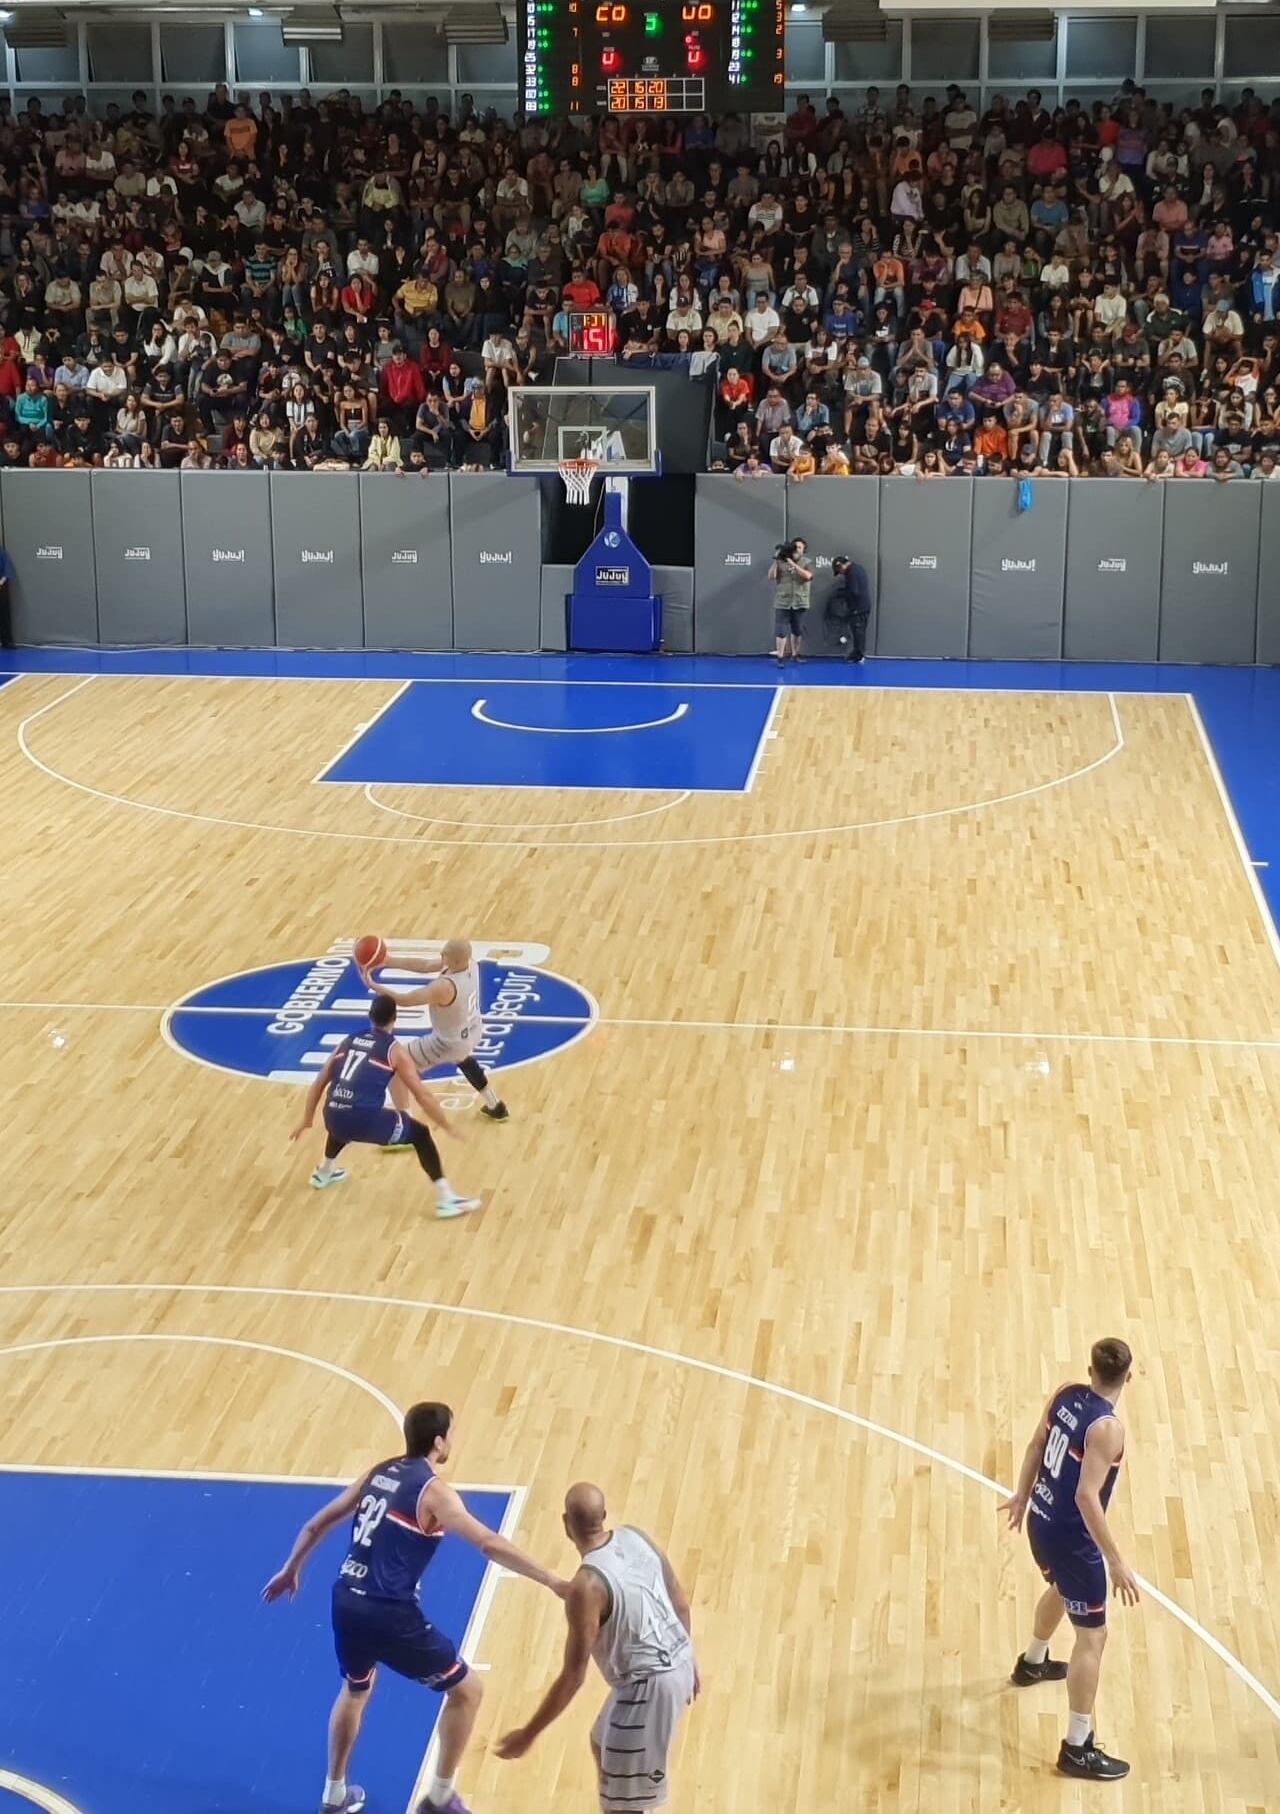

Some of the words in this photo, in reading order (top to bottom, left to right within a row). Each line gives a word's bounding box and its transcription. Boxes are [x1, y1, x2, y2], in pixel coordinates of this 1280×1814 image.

[611, 81, 626, 94] 22
[635, 81, 645, 94] 16
[648, 81, 664, 94] 20
[611, 97, 626, 109] 20
[635, 97, 645, 109] 15
[653, 97, 664, 109] 13
[266, 957, 351, 1034] GOBIERNO
[480, 971, 542, 1020] seguir
[340, 1049, 367, 1081] 17
[353, 1494, 388, 1547] 32
